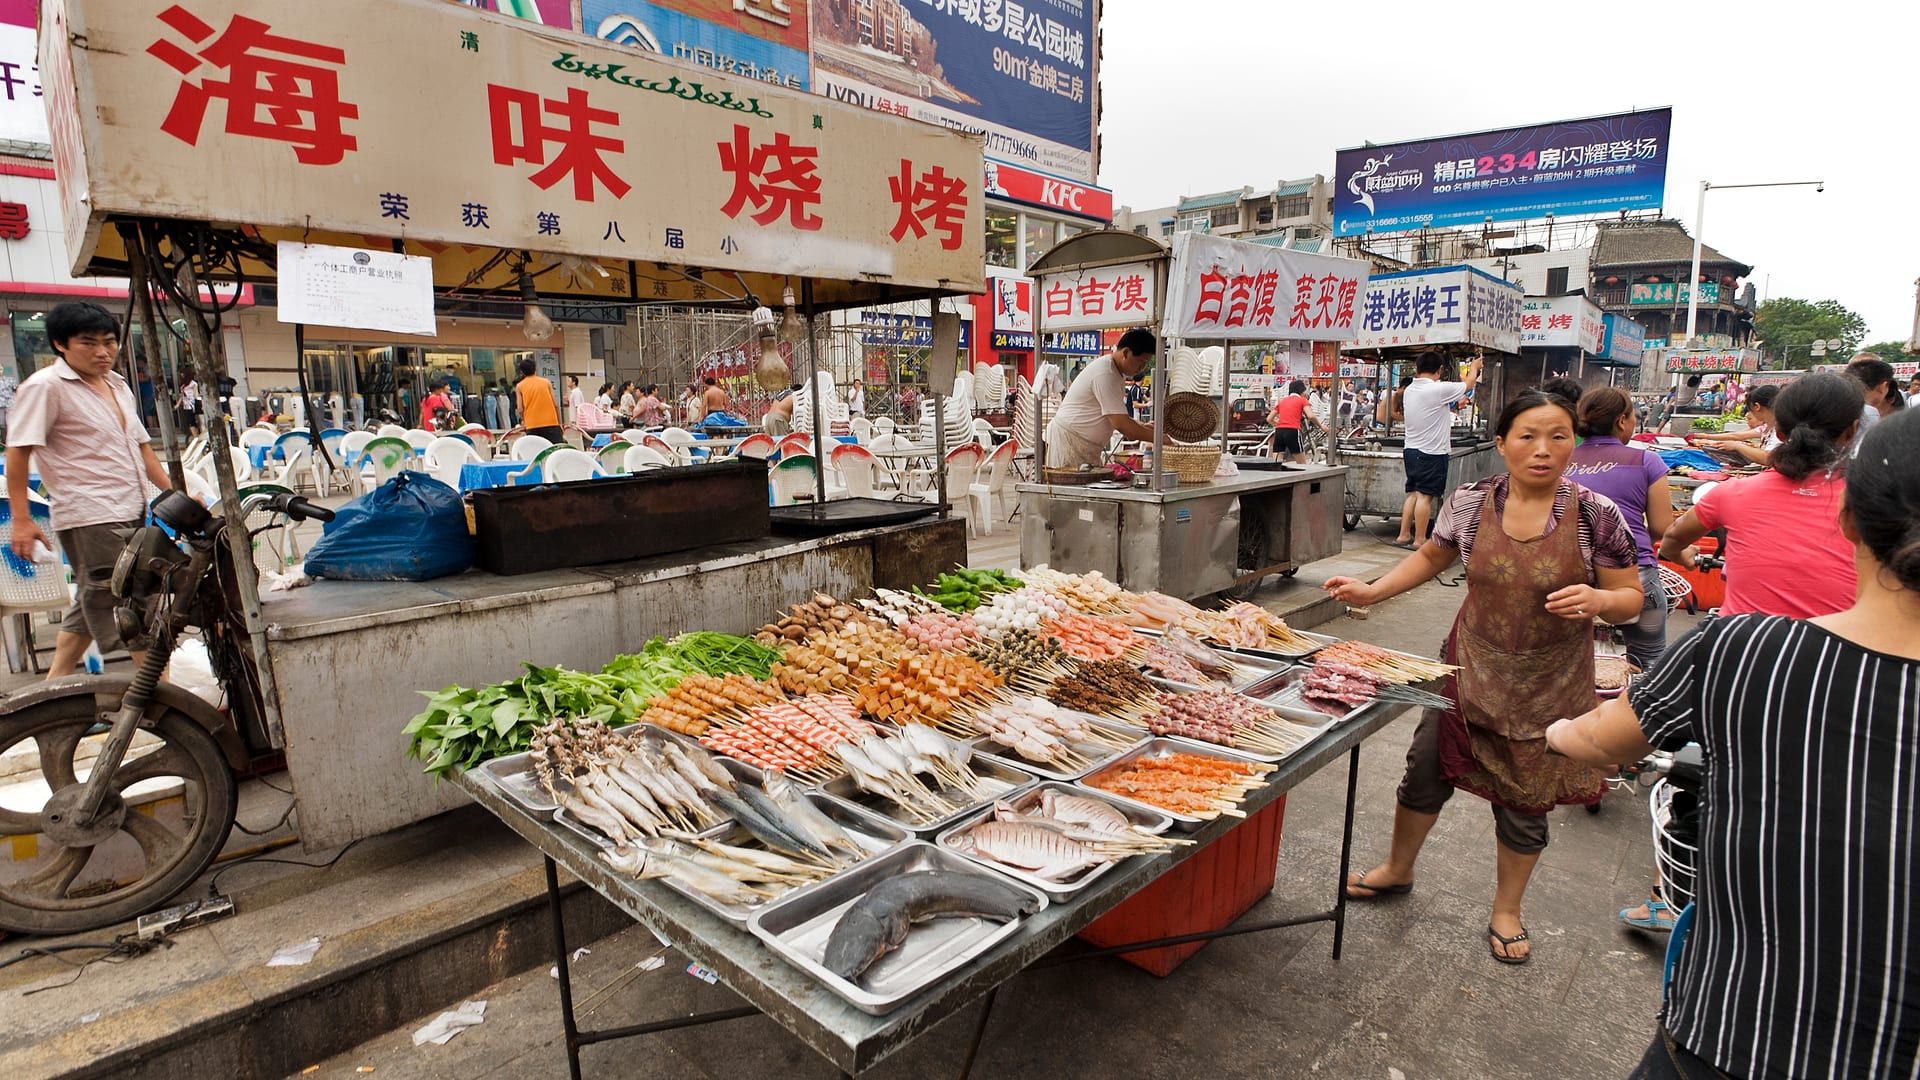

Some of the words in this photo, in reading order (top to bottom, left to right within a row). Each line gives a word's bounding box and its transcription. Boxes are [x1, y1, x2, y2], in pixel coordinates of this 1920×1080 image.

[919, 0, 1085, 70] 级多层公园城
[459, 29, 480, 53] 清
[812, 113, 824, 131] 真
[672, 39, 801, 90] 中国移动通信
[145, 4, 968, 251] 海味烧烤
[1040, 178, 1085, 212] KFC
[1045, 273, 1149, 319] 白吉馍
[1193, 262, 1280, 329] 白吉馍
[1288, 271, 1359, 330] 菜夹馍
[1362, 284, 1462, 332] 港烧烤王
[1014, 318, 1027, 328] KFC
[1668, 355, 1737, 369] 风味烧烤
[1565, 460, 1618, 477] Dido
